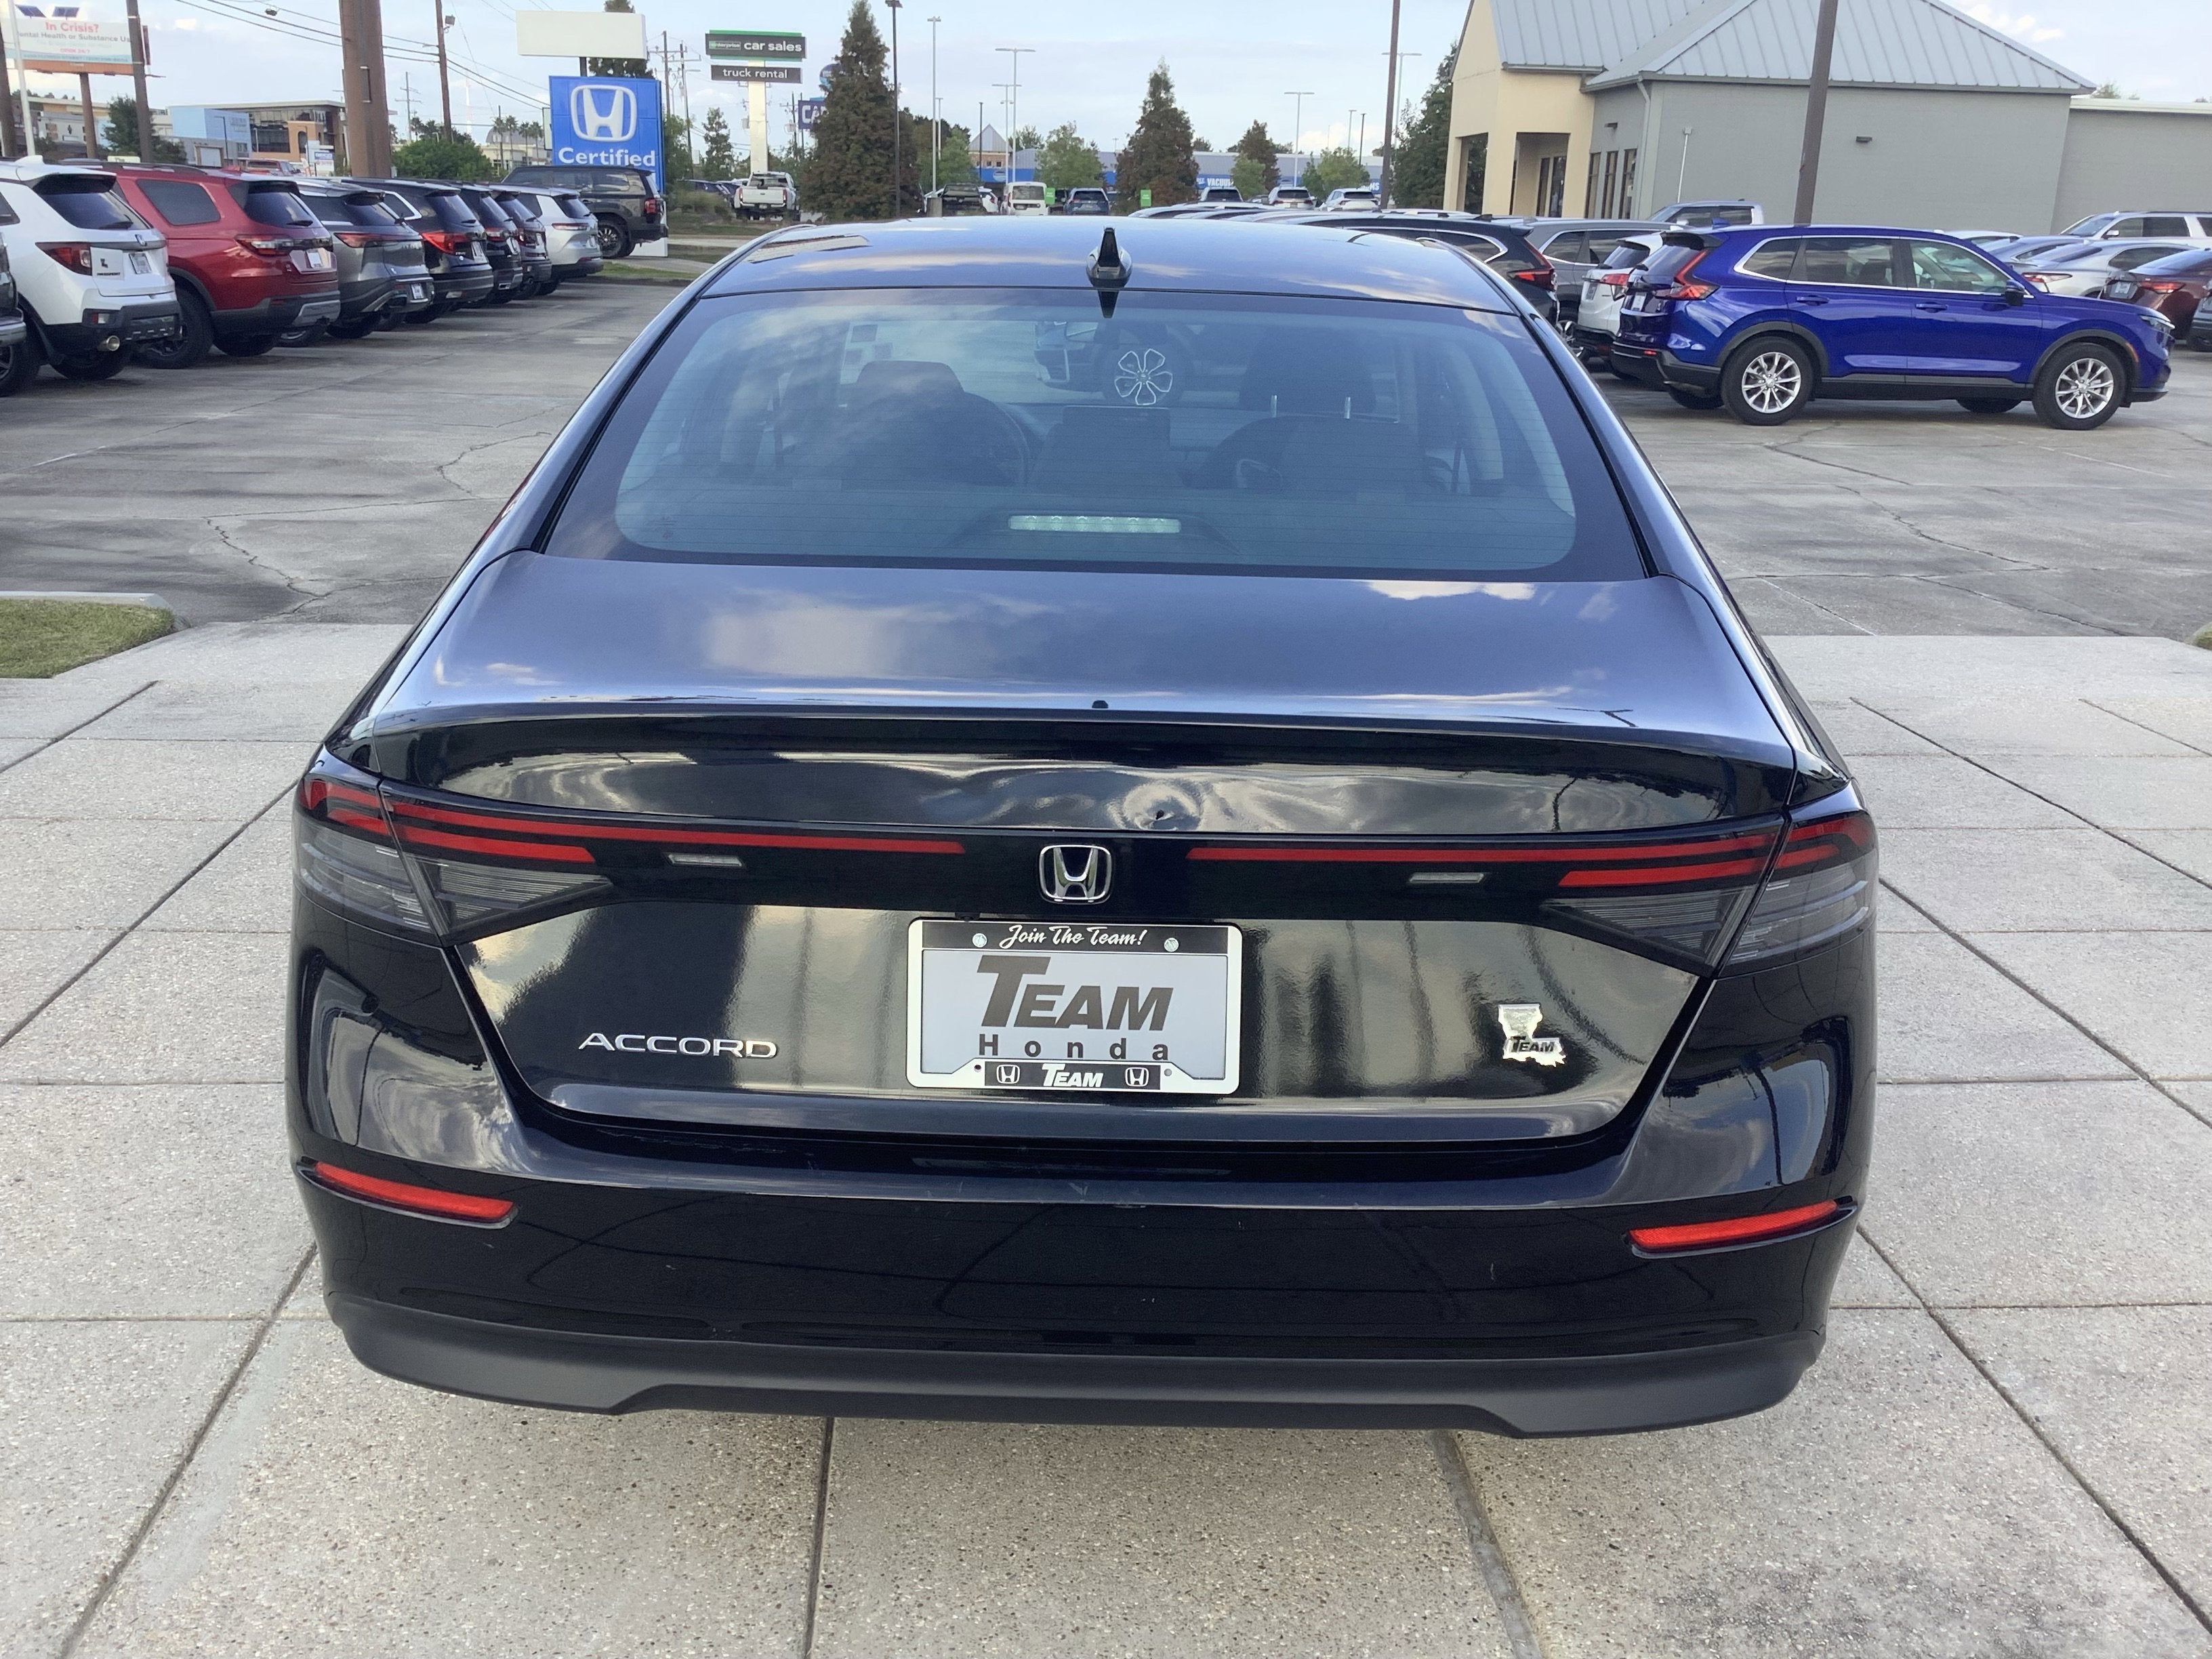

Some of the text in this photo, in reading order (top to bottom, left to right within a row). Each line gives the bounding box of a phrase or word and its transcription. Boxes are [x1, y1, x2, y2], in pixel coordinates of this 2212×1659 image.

[45, 22, 99, 33] In Crisis?
[79, 34, 118, 42] Substance
[743, 42, 765, 50] car
[768, 41, 802, 52] sales
[722, 68, 787, 79] truck rental
[558, 147, 656, 167] Certified
[999, 924, 1147, 949] Join The Team!
[977, 955, 1174, 1031] TEAM
[579, 1033, 777, 1059] ACCORD
[979, 1034, 1169, 1061] Honda
[1511, 1036, 1555, 1052] TEAM
[1042, 1063, 1103, 1088] TEAM
